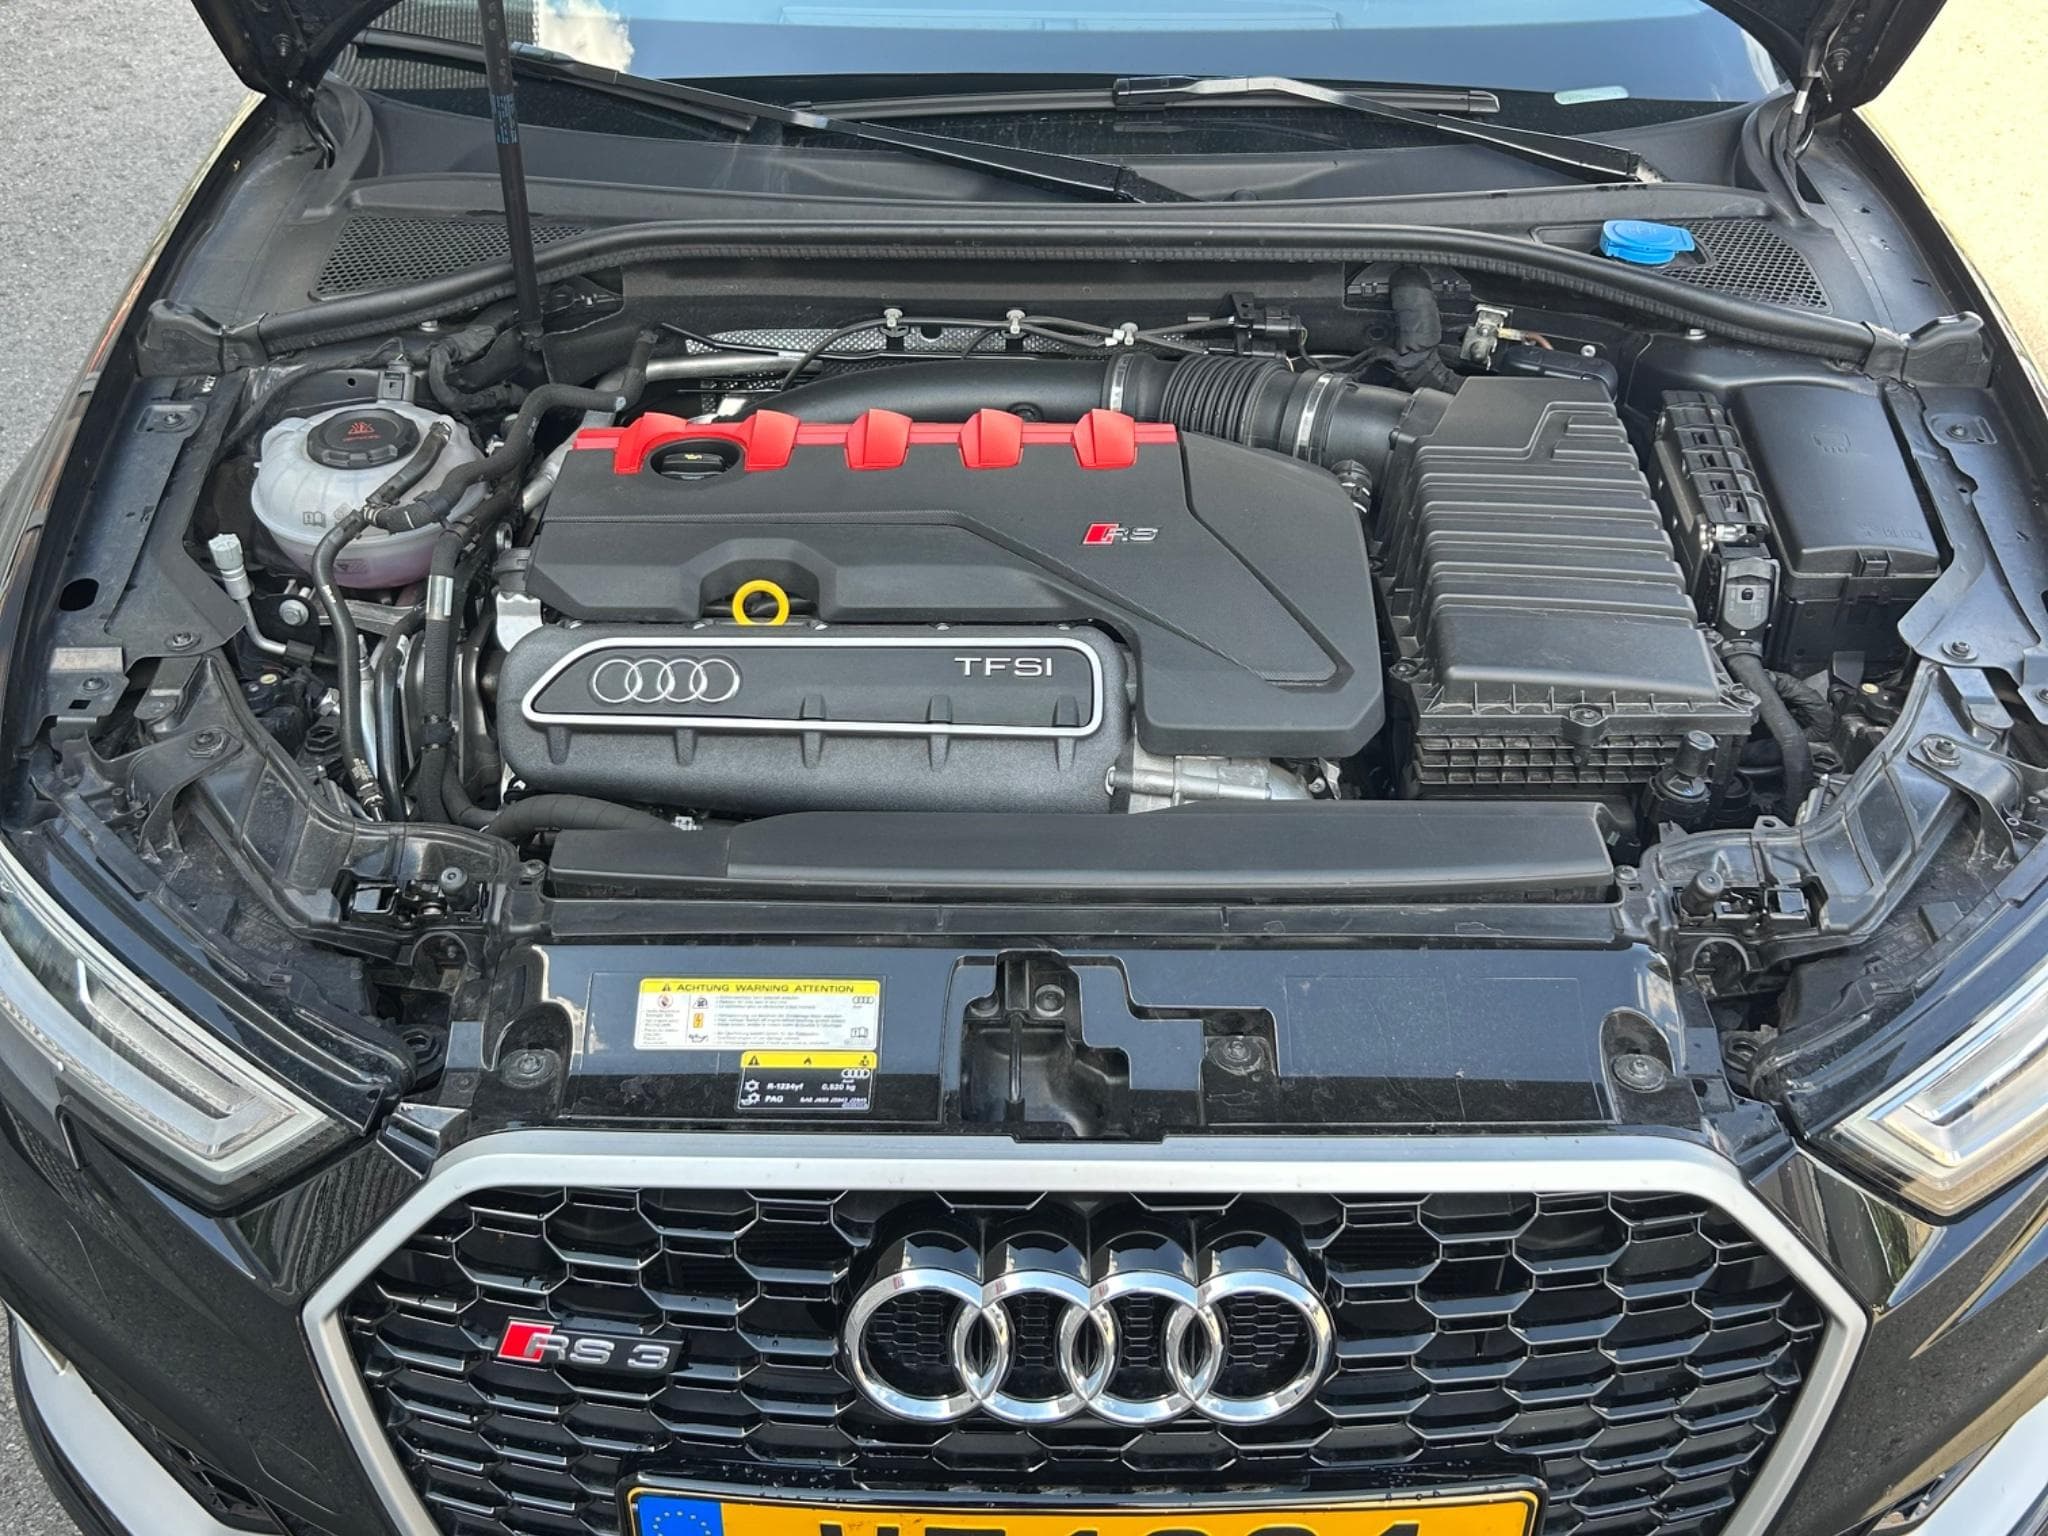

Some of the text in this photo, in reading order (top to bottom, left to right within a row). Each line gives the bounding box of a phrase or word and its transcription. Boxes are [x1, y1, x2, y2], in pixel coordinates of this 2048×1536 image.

[1100, 527, 1159, 544] RS
[954, 657, 1052, 676] TFSI
[677, 984, 854, 993] ACHTUNG WARNING ATTENTION
[523, 1331, 670, 1369] RS 3
